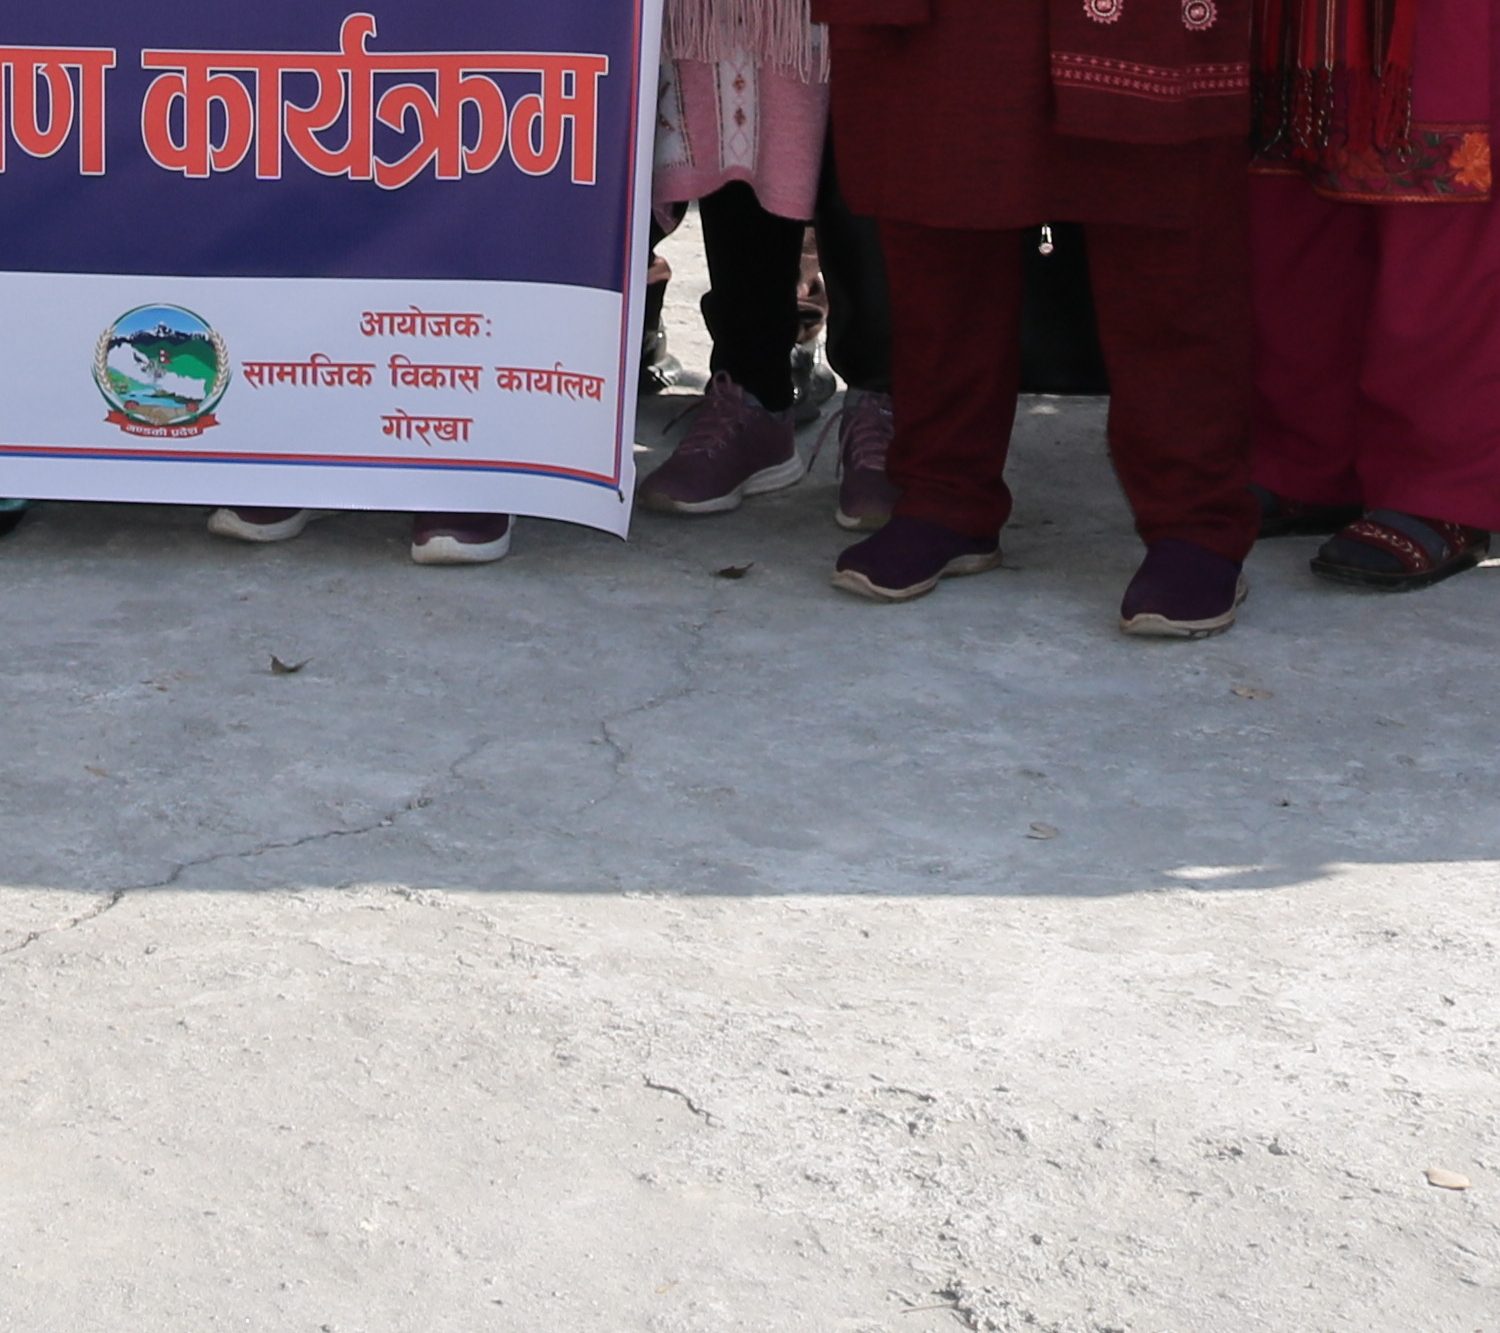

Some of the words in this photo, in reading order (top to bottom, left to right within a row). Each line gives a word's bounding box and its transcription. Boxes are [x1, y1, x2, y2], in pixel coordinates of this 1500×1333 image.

[140, 11, 610, 191] कार्यक्रम
[359, 305, 494, 338] आयोजक:
[241, 352, 376, 389] सामाजिक
[387, 354, 484, 393] विकास
[494, 361, 606, 402] कार्यालय
[380, 408, 474, 446] गोरखा
